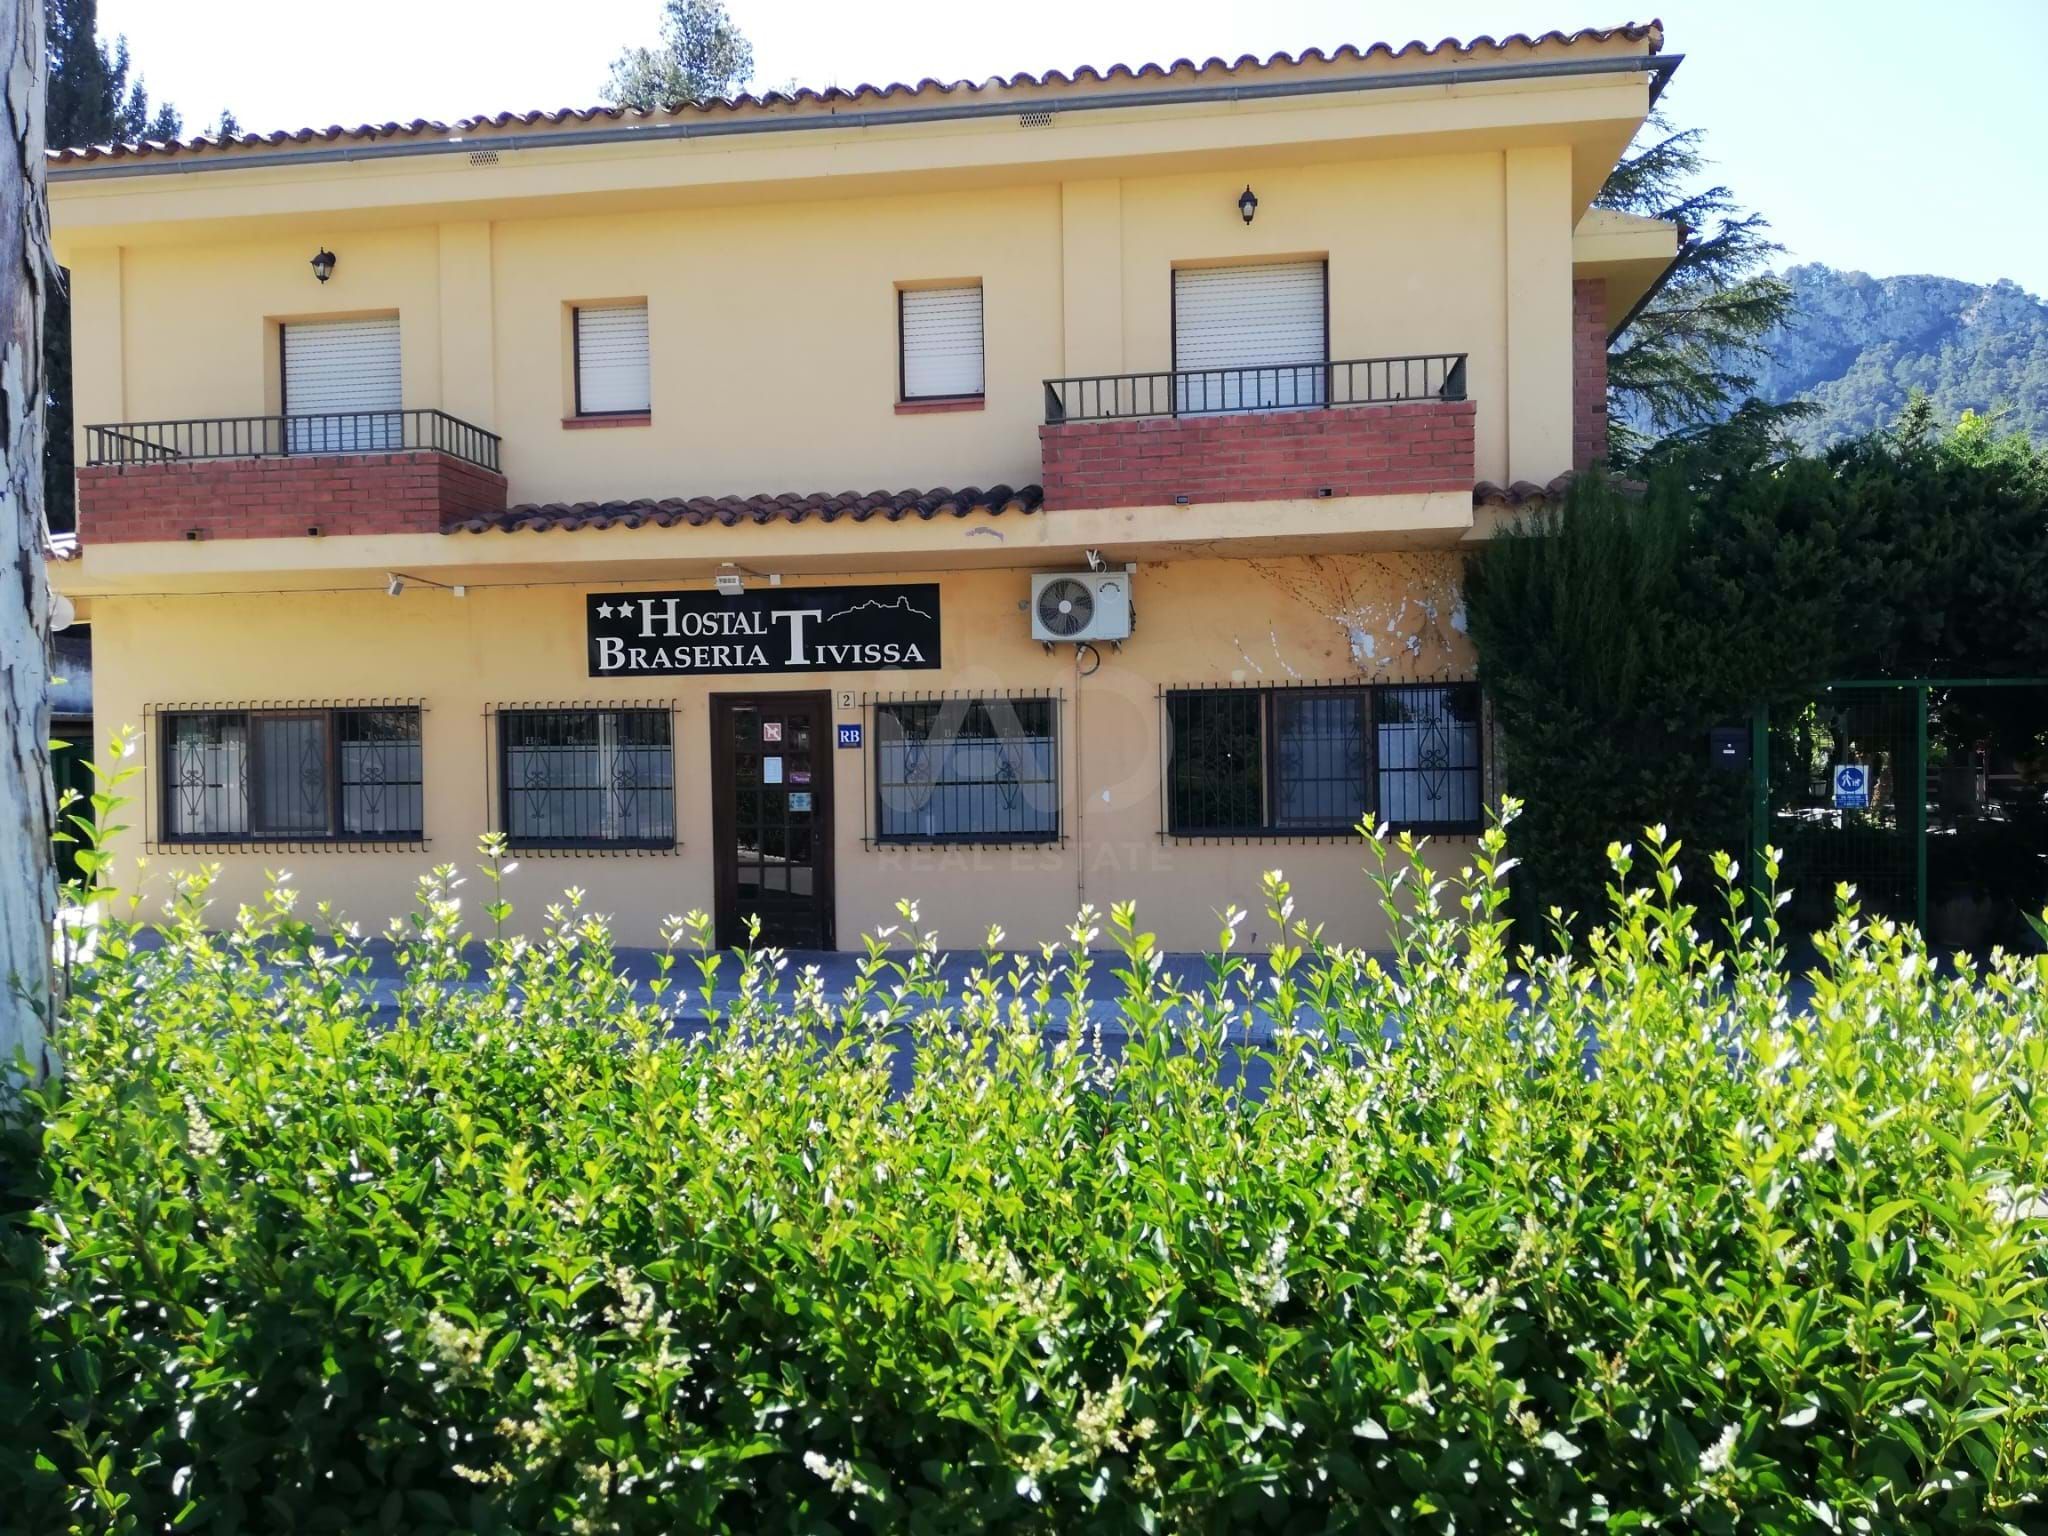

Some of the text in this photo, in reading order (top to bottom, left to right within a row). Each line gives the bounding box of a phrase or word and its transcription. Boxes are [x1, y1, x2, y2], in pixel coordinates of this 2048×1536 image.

[637, 598, 768, 638] HOSTAL
[595, 609, 926, 670] BRASERIA TIVISSA
[843, 694, 851, 707] 2
[840, 730, 860, 743] RB
